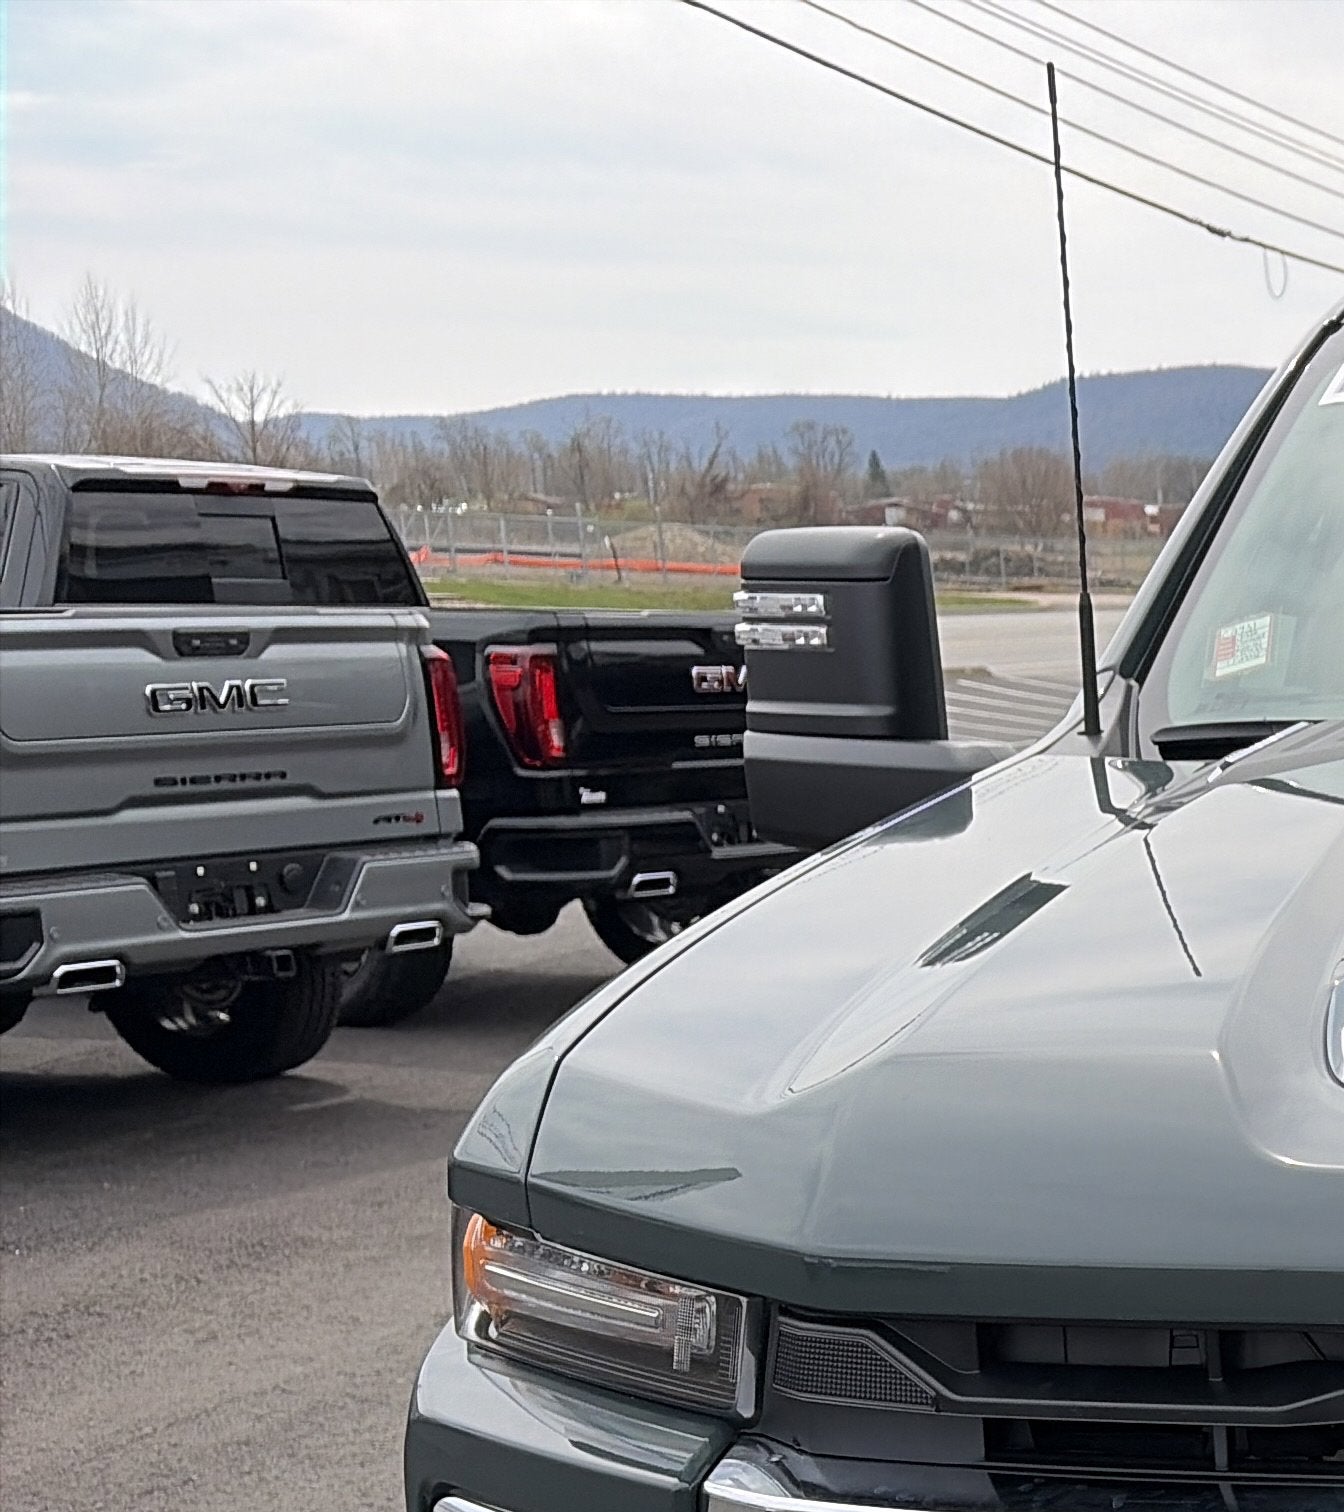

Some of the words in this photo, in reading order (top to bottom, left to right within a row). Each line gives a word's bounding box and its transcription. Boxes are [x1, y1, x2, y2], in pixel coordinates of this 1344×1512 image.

[691, 664, 747, 693] GM
[145, 678, 290, 713] GMC
[694, 733, 744, 748] SIER
[153, 770, 288, 788] SIERRA
